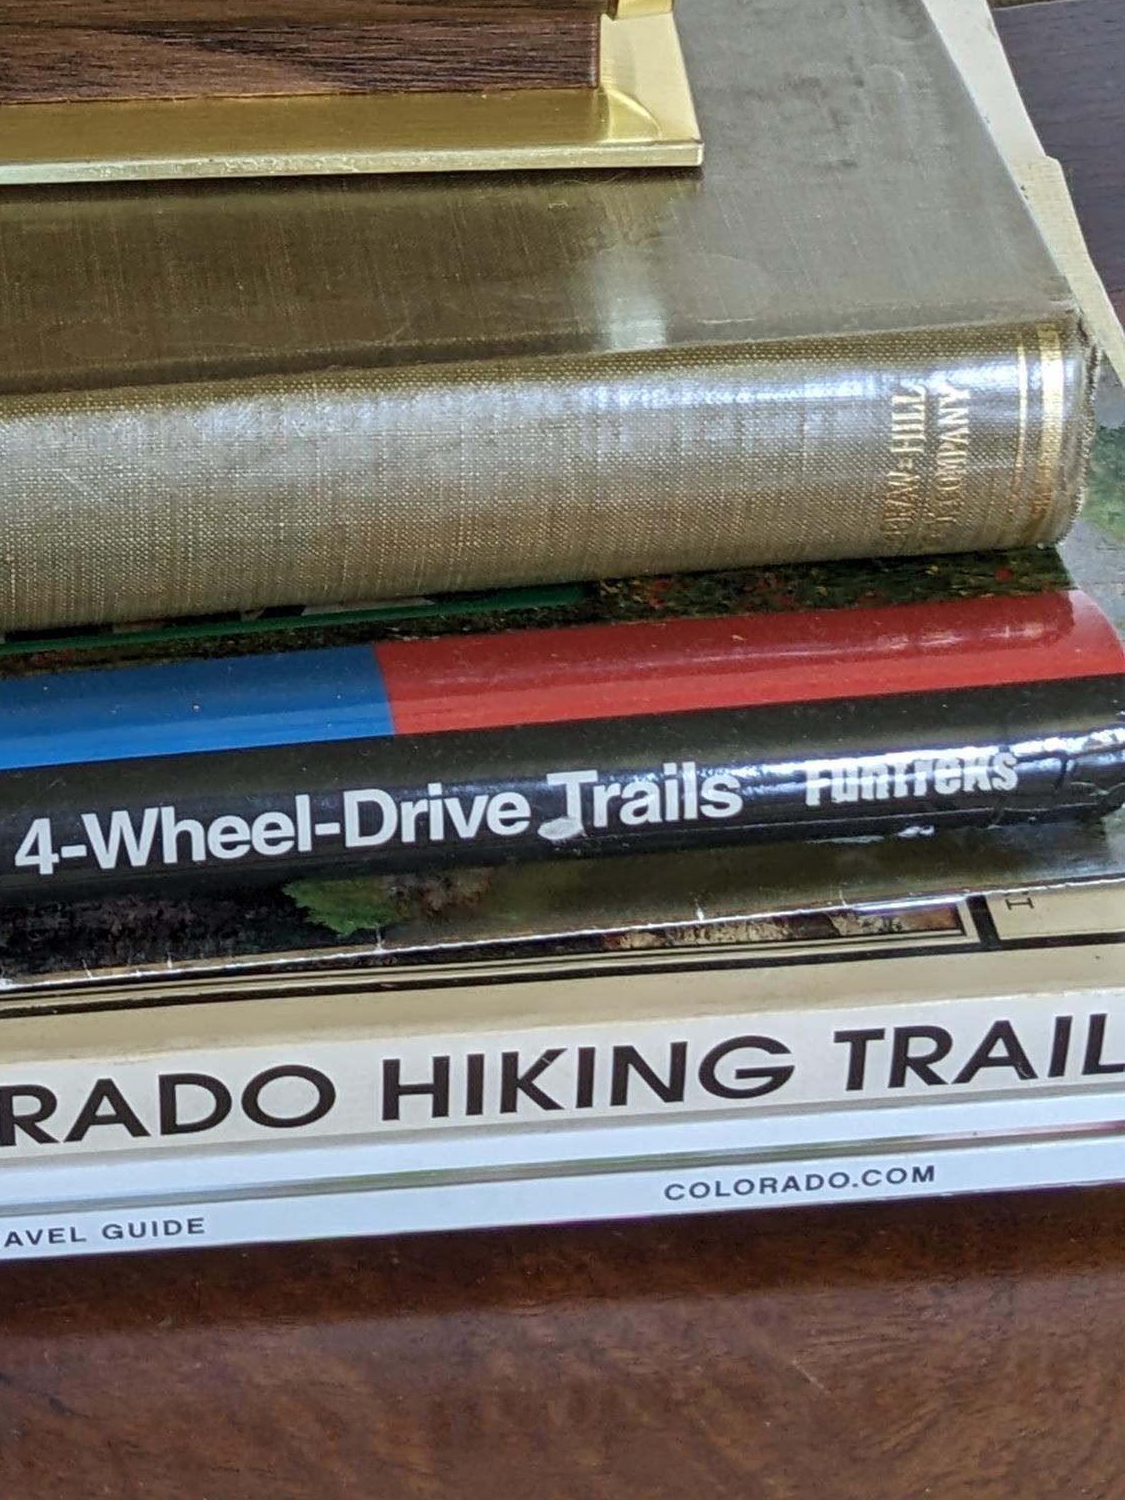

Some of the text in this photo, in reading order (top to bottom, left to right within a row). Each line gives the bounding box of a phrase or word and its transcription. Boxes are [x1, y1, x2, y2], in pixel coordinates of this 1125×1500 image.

[14, 782, 531, 875] 4-Wheel-Drive
[546, 761, 744, 829] Trails
[380, 1034, 796, 1122] HIKING
[663, 1164, 937, 1203] COLORADO.COM
[101, 1216, 208, 1241] GUIDE
